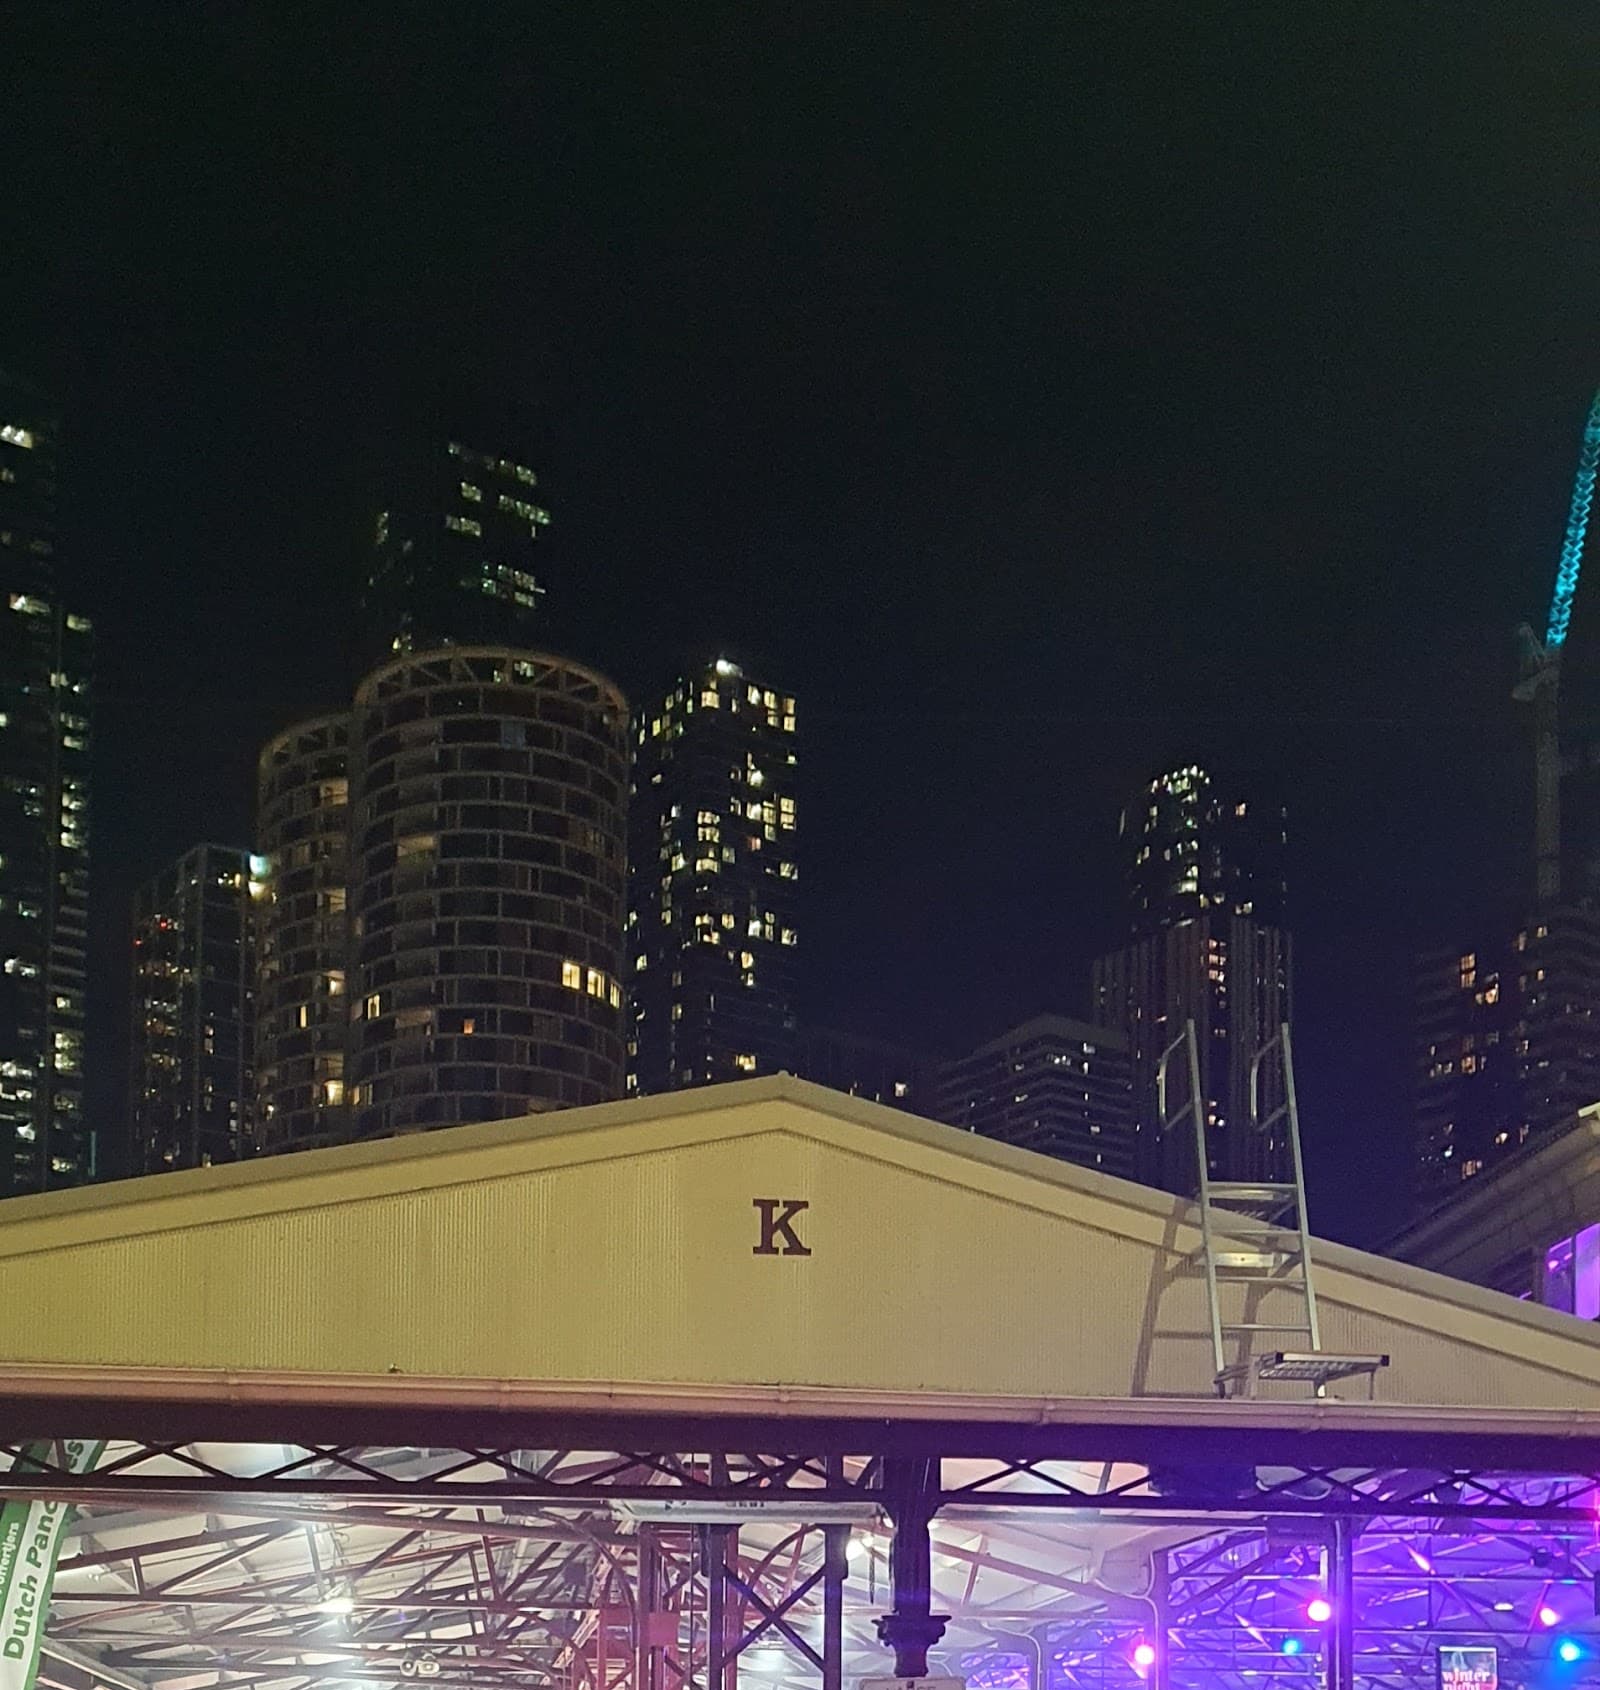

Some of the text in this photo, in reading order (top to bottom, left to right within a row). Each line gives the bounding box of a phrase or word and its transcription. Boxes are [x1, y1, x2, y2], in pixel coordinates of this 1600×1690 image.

[752, 1198, 811, 1256] K
[3, 1575, 38, 1660] Dutch
[1441, 1668, 1490, 1682] winter
